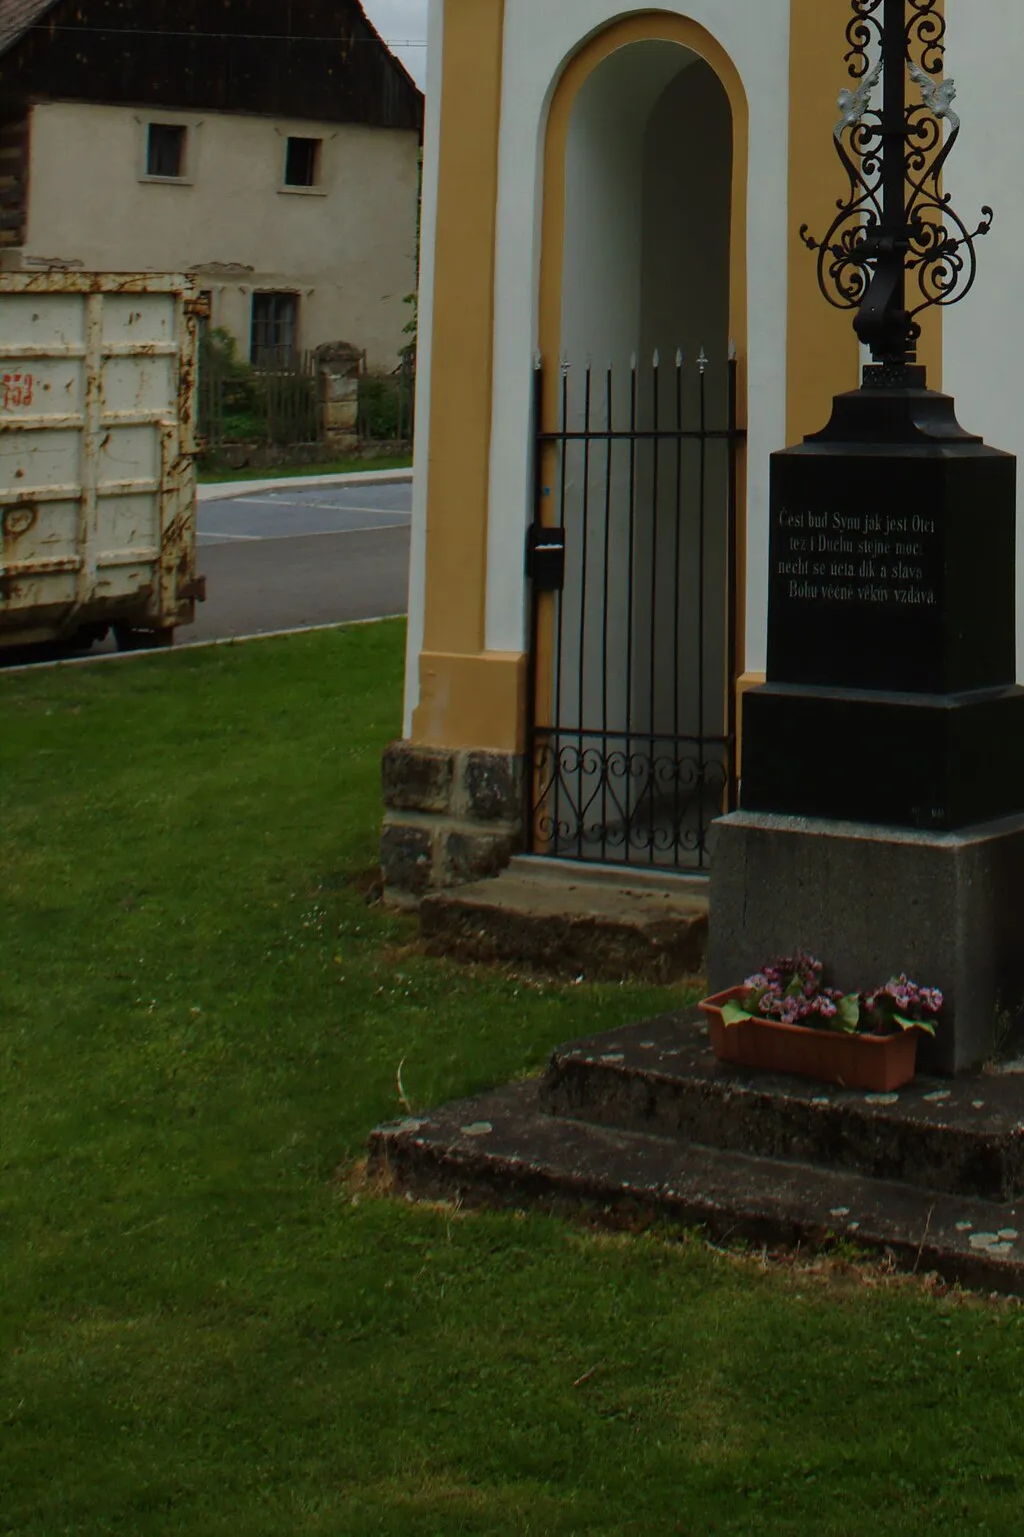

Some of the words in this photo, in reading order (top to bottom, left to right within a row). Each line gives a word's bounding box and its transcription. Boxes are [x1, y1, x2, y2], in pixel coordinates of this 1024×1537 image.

[832, 511, 860, 533] Synu
[862, 513, 881, 534] jak
[884, 515, 907, 535] jest
[912, 514, 934, 533] Otci
[818, 534, 853, 553] Duchu
[812, 563, 826, 575] se
[880, 565, 887, 578] a
[789, 579, 817, 598] Bohu
